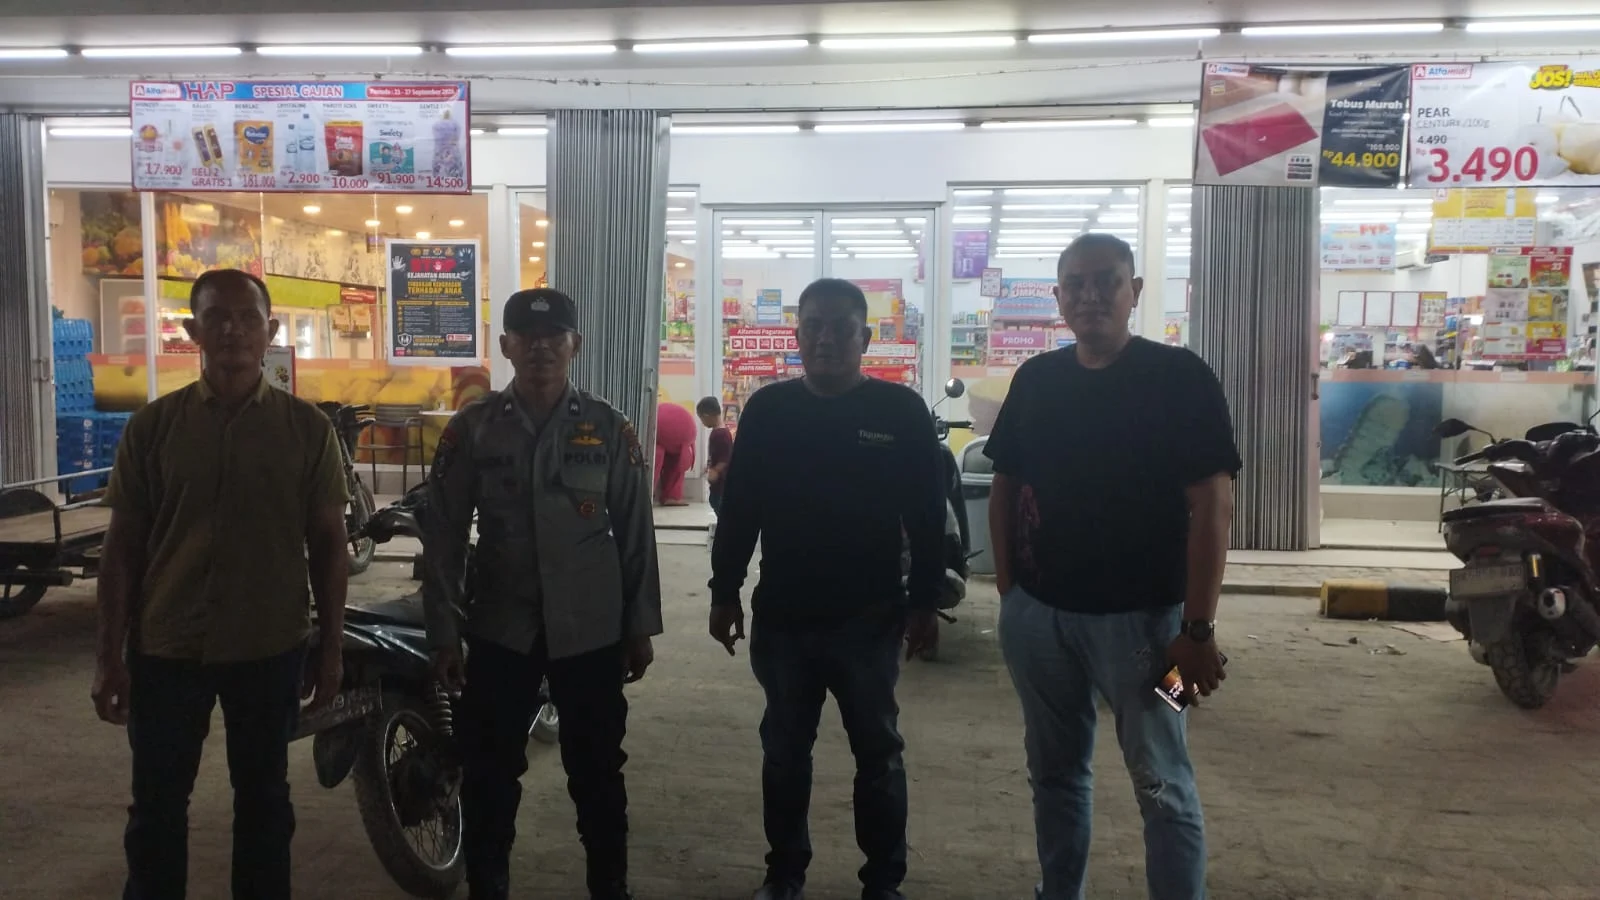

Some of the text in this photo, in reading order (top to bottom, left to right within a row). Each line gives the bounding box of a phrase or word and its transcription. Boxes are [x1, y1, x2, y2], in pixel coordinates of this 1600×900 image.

[184, 82, 235, 100] HAP
[253, 85, 344, 98] SPESIAL GAJIAN
[1330, 98, 1403, 109] Tebus Murah
[1417, 107, 1450, 118] PEAR
[1417, 134, 1448, 144] 4.490
[1331, 151, 1400, 168] 44.900
[1427, 146, 1538, 182] 3.490
[145, 162, 182, 175] 17.900
[192, 178, 225, 187] GRATIS
[288, 171, 320, 184] 2.900
[332, 176, 368, 189] 10.000
[377, 172, 415, 184] 91.900
[425, 176, 463, 188] 14.500
[1002, 337, 1034, 345] PROMO
